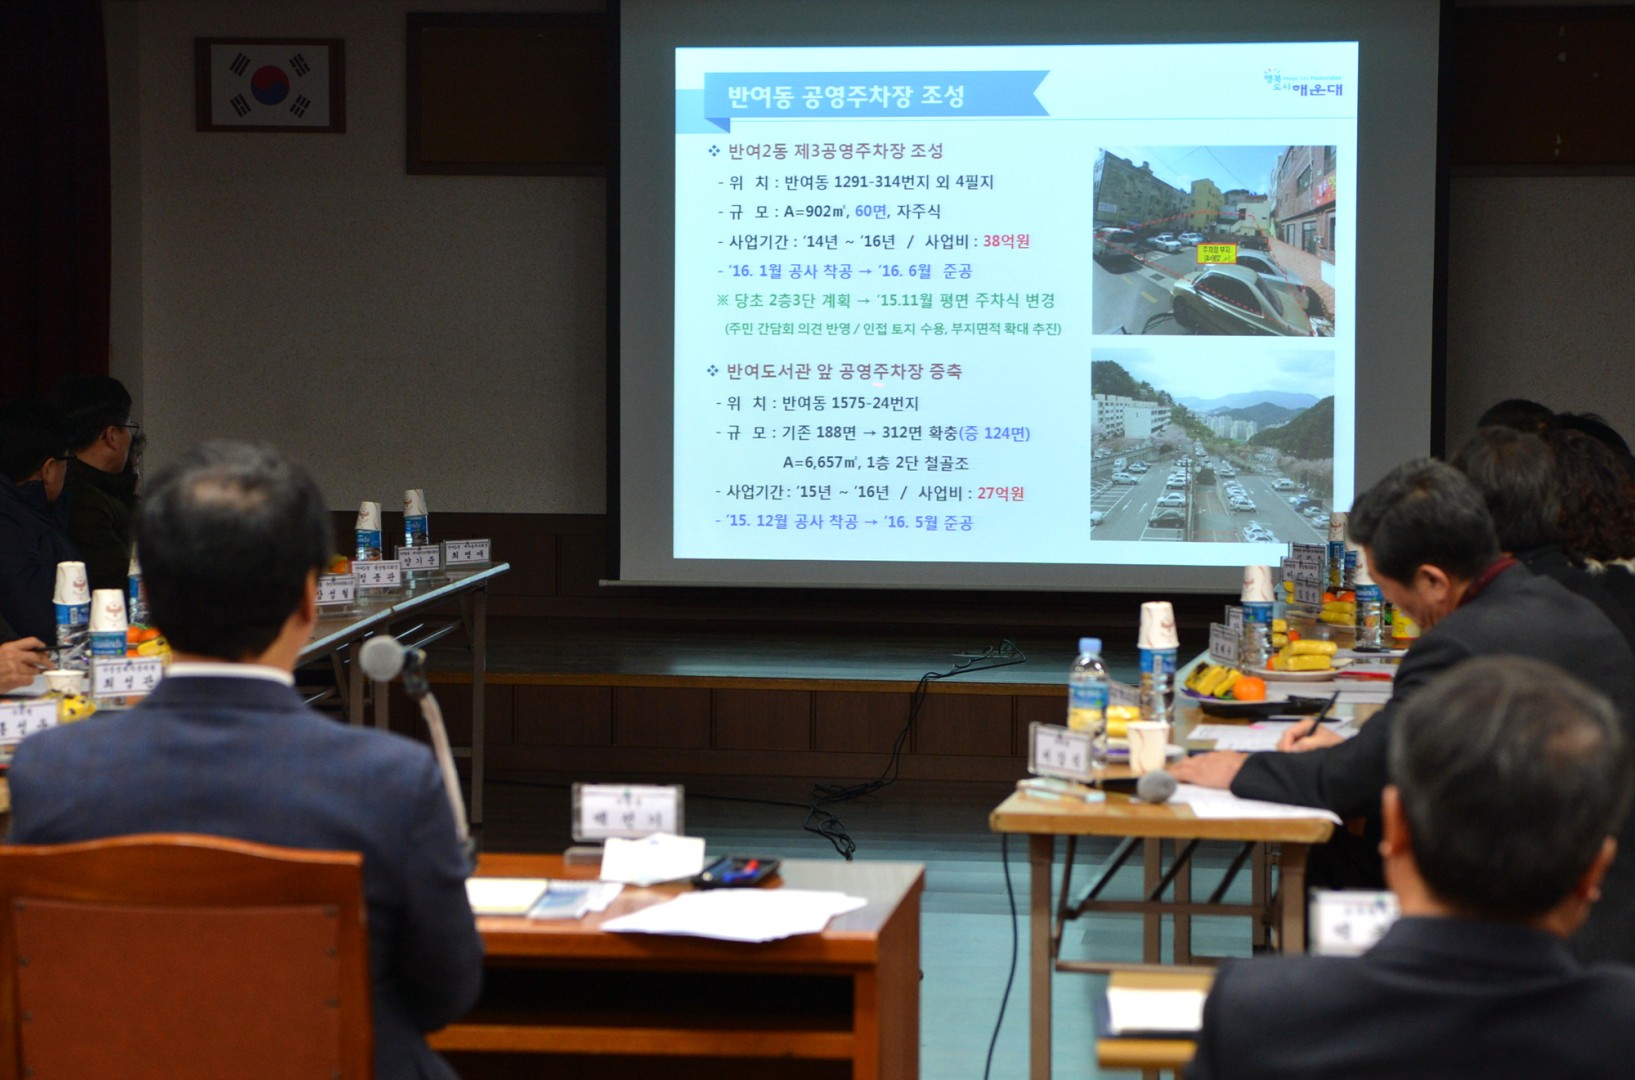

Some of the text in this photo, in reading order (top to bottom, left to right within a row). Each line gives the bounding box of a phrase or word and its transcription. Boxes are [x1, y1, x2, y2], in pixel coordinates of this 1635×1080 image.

[728, 85, 964, 109] 반여동 공영주차장 조성
[1292, 83, 1343, 97] 해운대
[728, 142, 943, 161] 반여2동 제3공영주차장 조성
[729, 175, 743, 191] 위
[755, 175, 769, 191] 치
[784, 174, 830, 191] 반여동
[834, 174, 930, 191] 1291-314번지
[935, 174, 950, 191] 외
[955, 174, 994, 191] 4필지
[729, 204, 744, 221] 규
[755, 205, 769, 219] 모
[855, 203, 891, 220] 60면,
[896, 203, 941, 220] 자주식
[728, 234, 789, 251] 사업기간
[924, 233, 969, 251] 사업비
[983, 233, 1030, 250] 38억원
[759, 263, 782, 280] 1월
[788, 263, 818, 280] 공사
[823, 263, 853, 280] 착공
[908, 263, 931, 280] 6월
[943, 263, 973, 280] 준공
[735, 293, 764, 309] 당초
[768, 293, 816, 309] 2층3단
[822, 293, 851, 309] 계획
[940, 293, 969, 309] 평면
[975, 292, 1019, 309] 주차식
[1025, 292, 1055, 309] 변경
[725, 322, 753, 336] (주민
[758, 322, 794, 336] 간담회
[797, 322, 822, 336] 의견
[826, 322, 851, 336] 반영
[863, 322, 888, 336] 인접
[891, 322, 916, 336] 토지
[920, 322, 948, 336] 수용,
[951, 322, 1001, 336] 부지면적
[1004, 322, 1029, 336] 확대
[1032, 322, 1062, 336] 추진)
[727, 362, 963, 381] 반여도서관 앞 공영주차장 증축
[726, 395, 741, 412] 위
[752, 395, 766, 412] 치
[782, 395, 827, 412] 반여동
[831, 395, 919, 412] 1575-24번지
[726, 424, 741, 441] 규
[752, 426, 767, 440] 모
[782, 424, 812, 441] 기존
[816, 425, 856, 442] 188면
[882, 425, 922, 441] 312면
[984, 426, 1031, 443] 124면)
[866, 455, 890, 472] 1층
[895, 455, 920, 472] 2단
[924, 455, 969, 472] 철골조
[726, 483, 785, 501] 사업기간
[918, 485, 963, 502] 사업비
[977, 486, 1024, 503] 27억원
[757, 513, 788, 530] 12월
[794, 513, 824, 530] 공사
[829, 514, 858, 530] 착공
[915, 515, 938, 532] 5월
[943, 515, 974, 532] 준공
